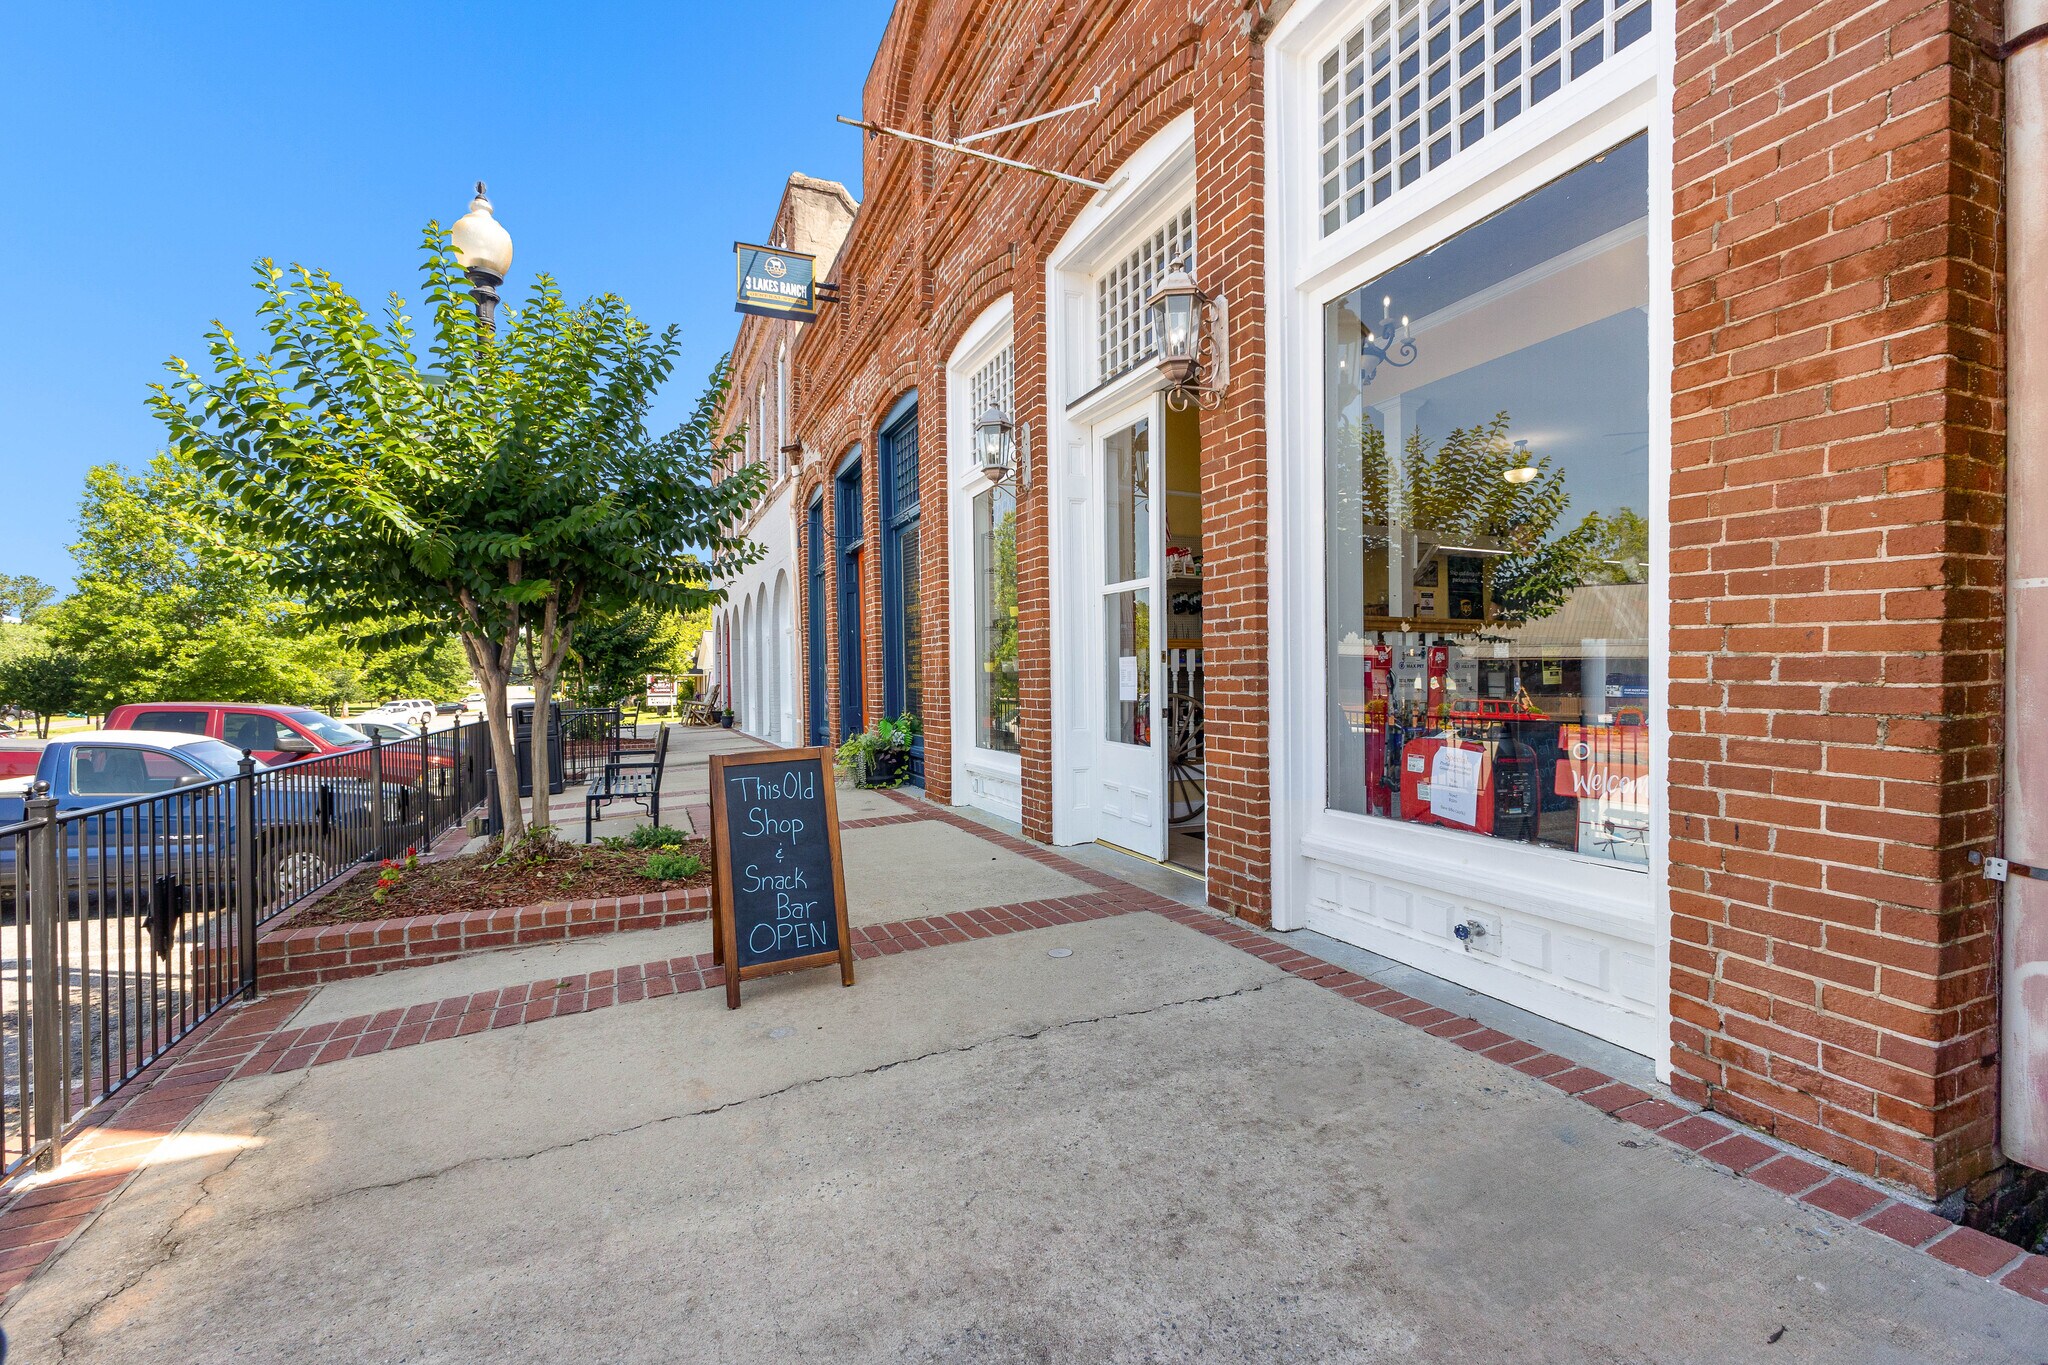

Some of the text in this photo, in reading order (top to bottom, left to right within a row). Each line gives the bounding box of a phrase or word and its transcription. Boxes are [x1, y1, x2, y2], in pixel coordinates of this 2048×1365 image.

[745, 276, 752, 289] 3
[752, 277, 779, 293] LAKES
[780, 281, 807, 299] RANCH
[731, 771, 814, 802] This Old
[742, 807, 804, 845] Shop
[775, 843, 785, 863] &
[742, 865, 808, 893] Snack
[776, 892, 818, 920] Bar
[750, 920, 827, 954] OPEN
